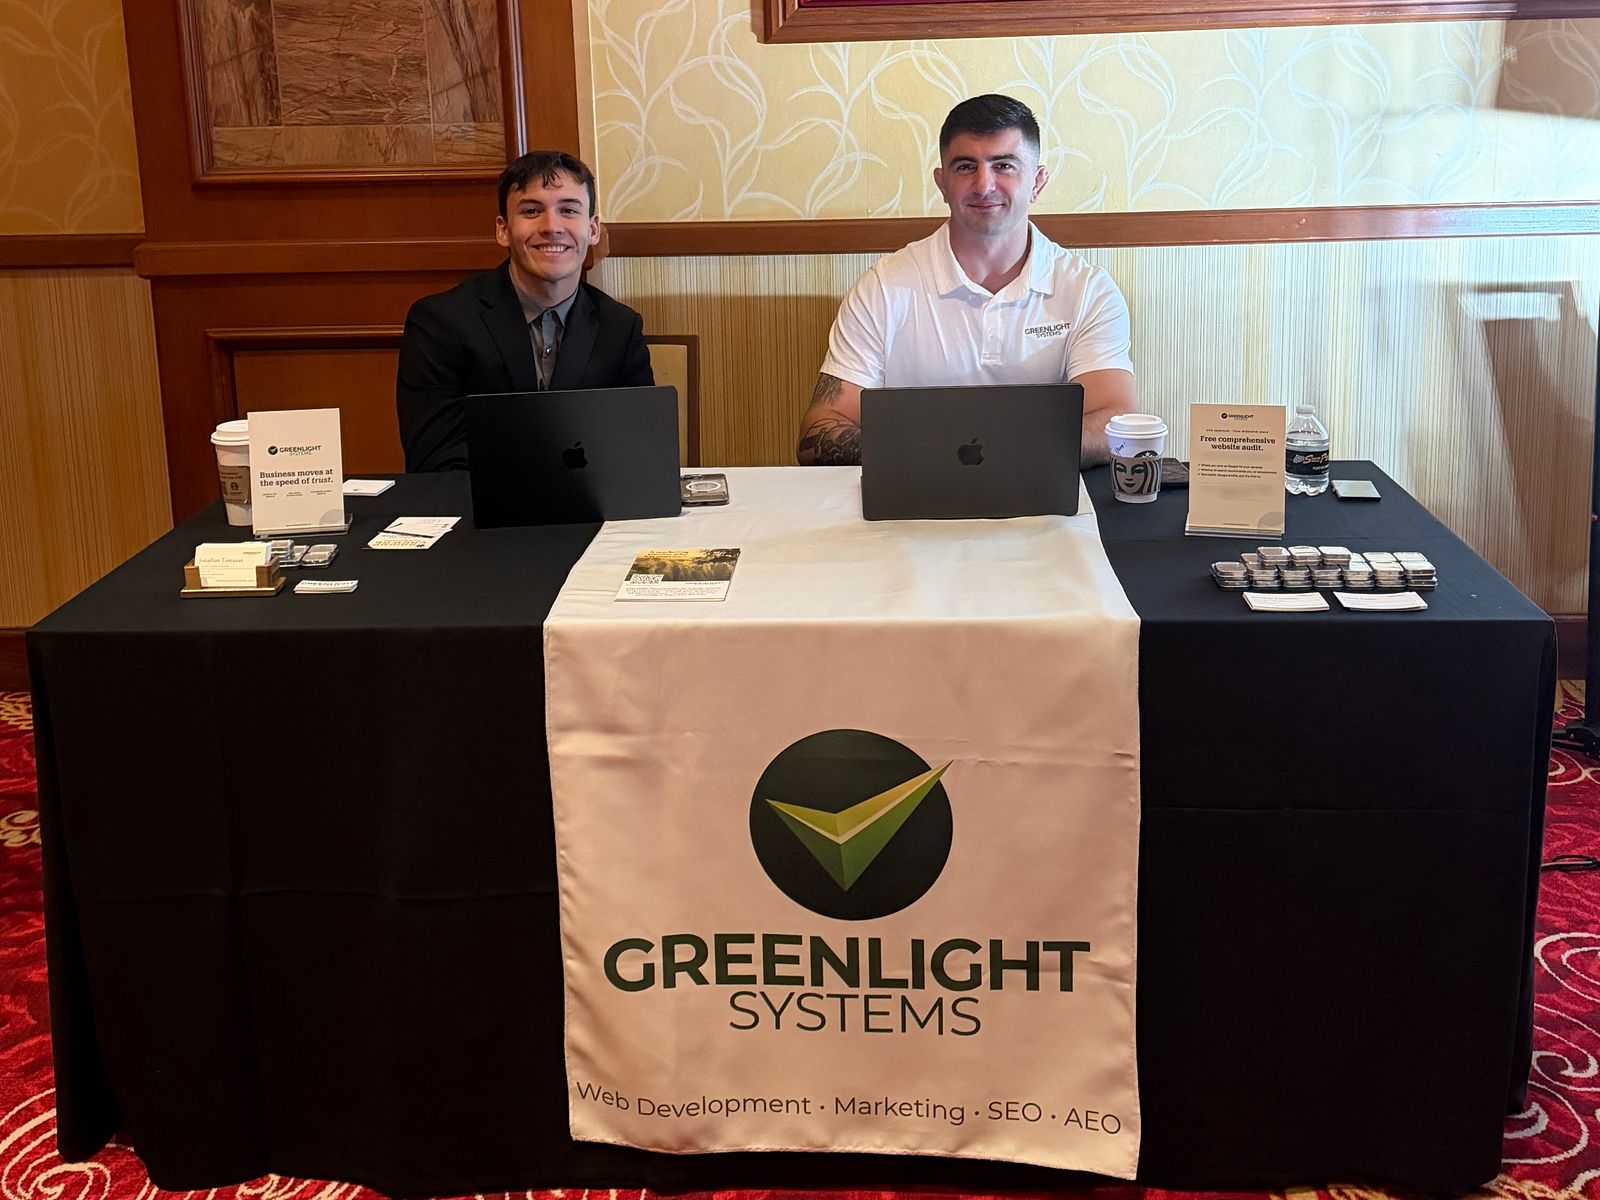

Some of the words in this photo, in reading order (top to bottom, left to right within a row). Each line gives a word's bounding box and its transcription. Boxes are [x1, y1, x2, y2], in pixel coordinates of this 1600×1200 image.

[1025, 323, 1070, 334] GREENLIGHT
[279, 445, 322, 453] GREENLIGHT
[260, 479, 274, 487] the
[275, 478, 300, 487] speed
[311, 476, 334, 484] trust.
[603, 933, 1091, 992] GREENLIGHT
[729, 991, 982, 1036] SYSTEMS
[576, 1081, 630, 1110] Web
[637, 1096, 812, 1118] Development
[834, 1096, 965, 1126] Marketing
[987, 1101, 1042, 1122] SEO
[1064, 1107, 1121, 1135] AEO
